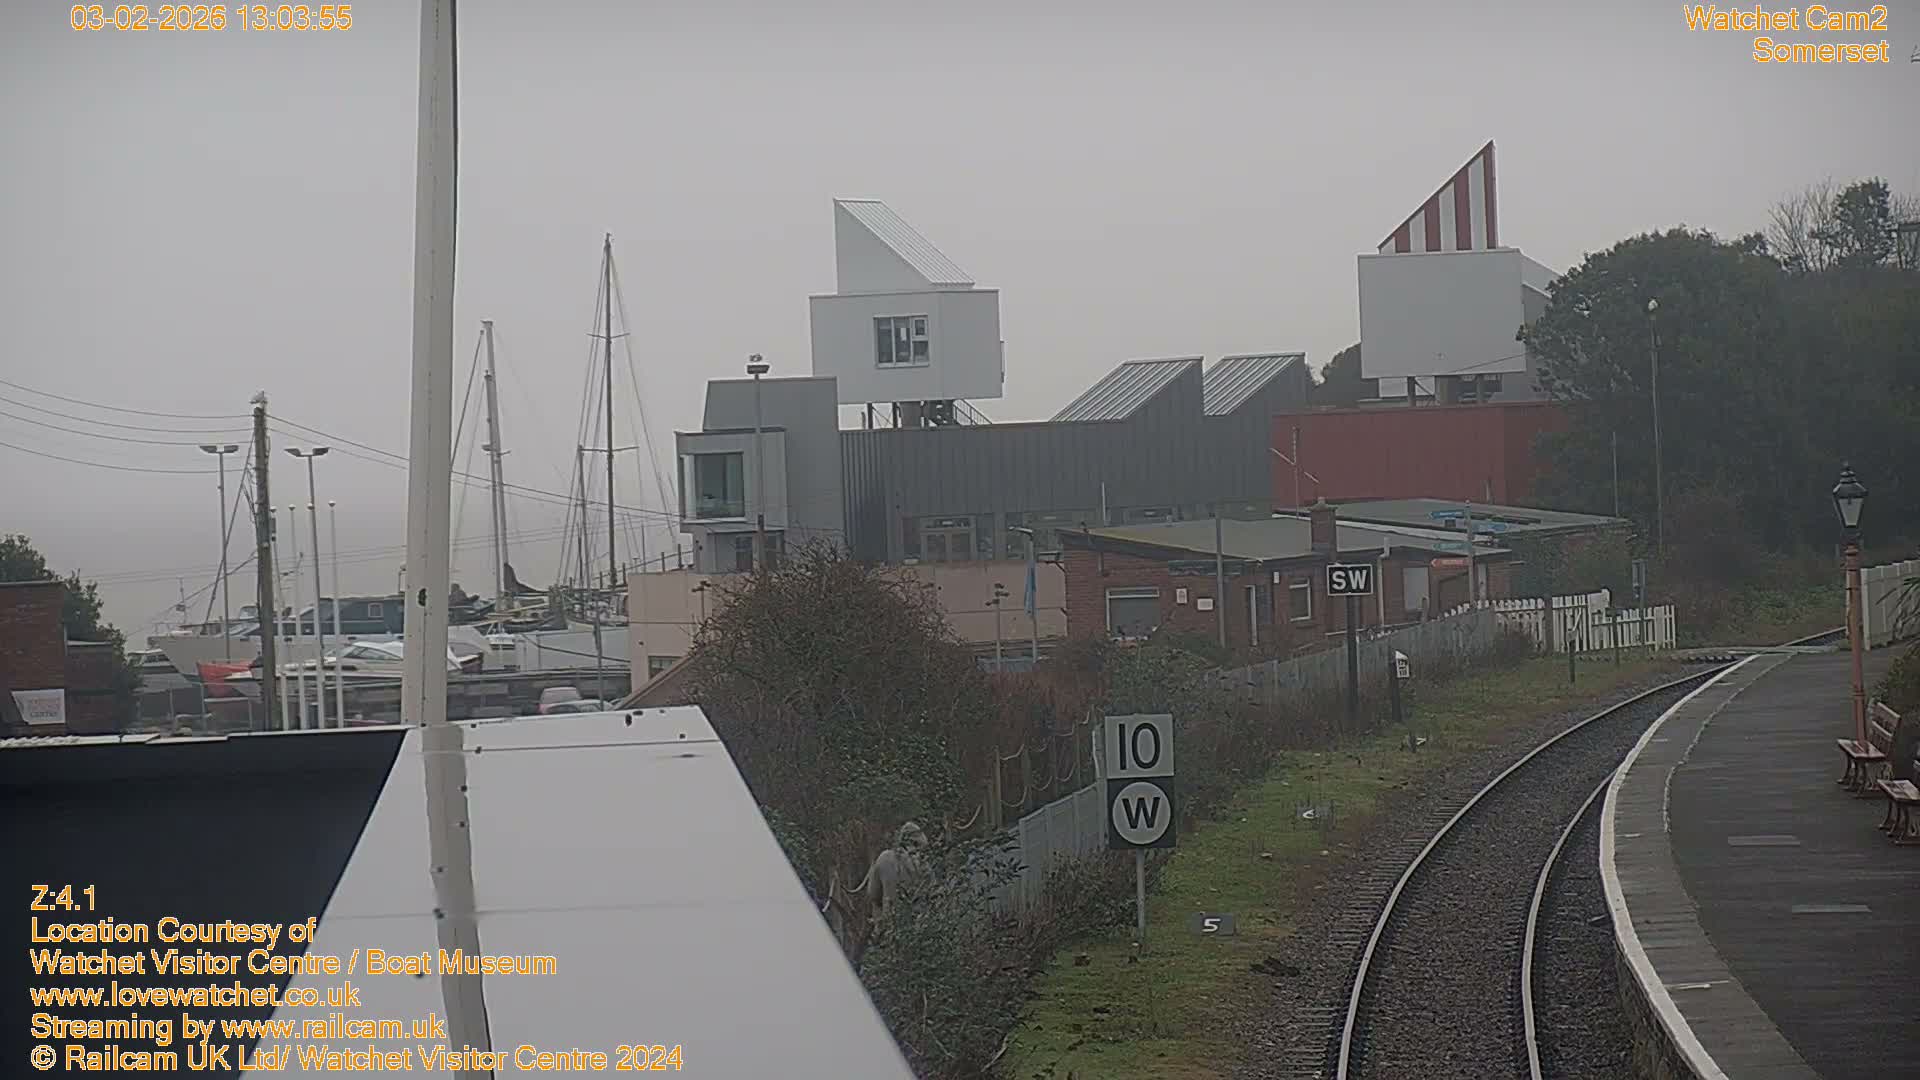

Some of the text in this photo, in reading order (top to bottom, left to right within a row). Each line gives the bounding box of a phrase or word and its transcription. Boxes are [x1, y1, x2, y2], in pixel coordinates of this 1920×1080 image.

[1332, 569, 1367, 591] SW
[1117, 722, 1161, 771] 10
[1122, 796, 1161, 830] W
[1201, 918, 1221, 933] 5
